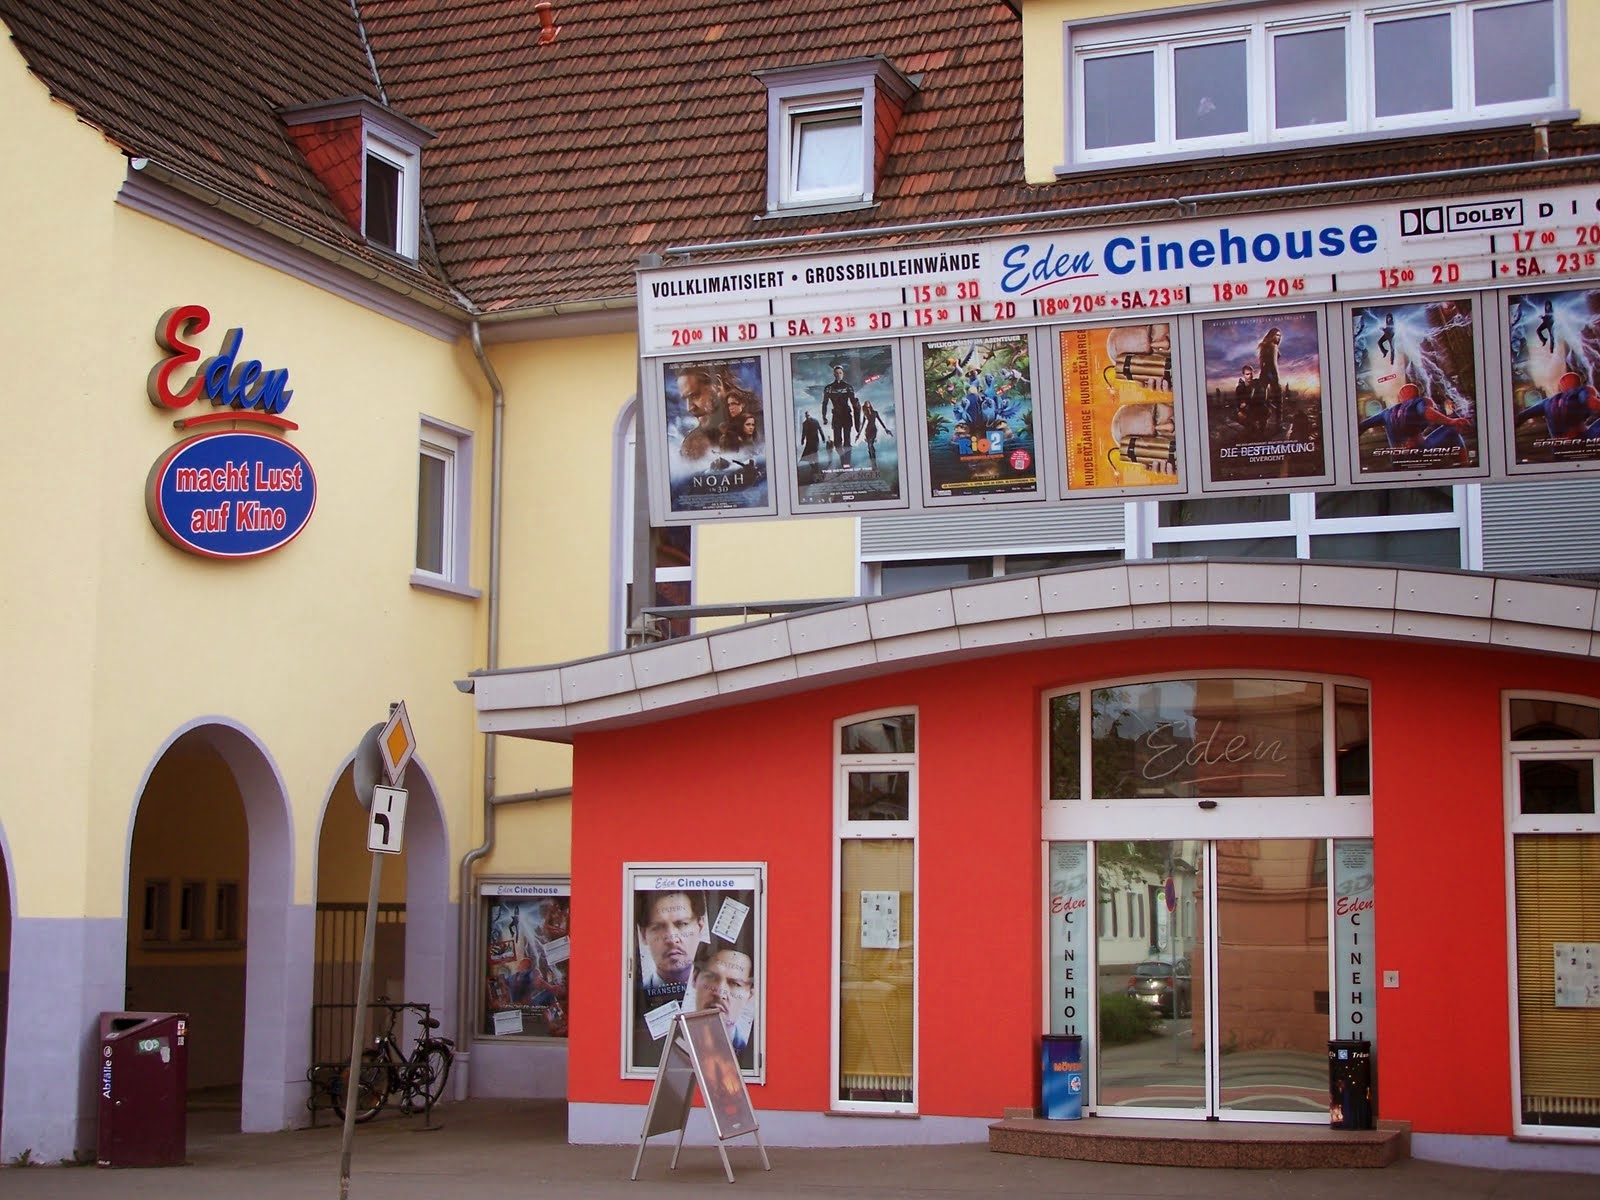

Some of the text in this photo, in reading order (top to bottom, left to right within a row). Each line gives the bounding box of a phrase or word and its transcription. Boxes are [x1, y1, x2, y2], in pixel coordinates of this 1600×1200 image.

[1455, 206, 1516, 225] DOLBY
[1000, 223, 1378, 293] Eden Cinehouse
[1515, 256, 1546, 277] SA.
[652, 252, 981, 298] VOLLKLIMATISIERT GROSSBILDLEINWÄNDE
[957, 280, 980, 300] 3D
[960, 303, 981, 322] IN
[994, 300, 1016, 320] 2D
[712, 325, 729, 343] IN
[737, 322, 758, 341] 3D
[787, 319, 814, 336] SA.
[868, 311, 892, 330] 3D
[984, 335, 1021, 344] ABENTEUER
[148, 304, 294, 414] Eden
[990, 431, 1003, 454] 2
[1081, 409, 1095, 486] HUNDERTJÄHRIGE
[1220, 447, 1238, 458] DIE
[1241, 442, 1315, 457] BESTIMMUNG
[1372, 447, 1450, 456] SPIDER-MAN
[1249, 455, 1285, 463] DIVERGENT
[176, 461, 303, 492] macht Lust
[693, 473, 744, 488] NOAH
[191, 501, 286, 533] auf Kino
[1142, 720, 1287, 780] Eden
[514, 885, 558, 895] Cinehouse
[677, 878, 735, 888] Cinehouse
[1051, 896, 1086, 914] Eden
[1336, 897, 1374, 915] Eden
[102, 1060, 112, 1099] Abfälle
